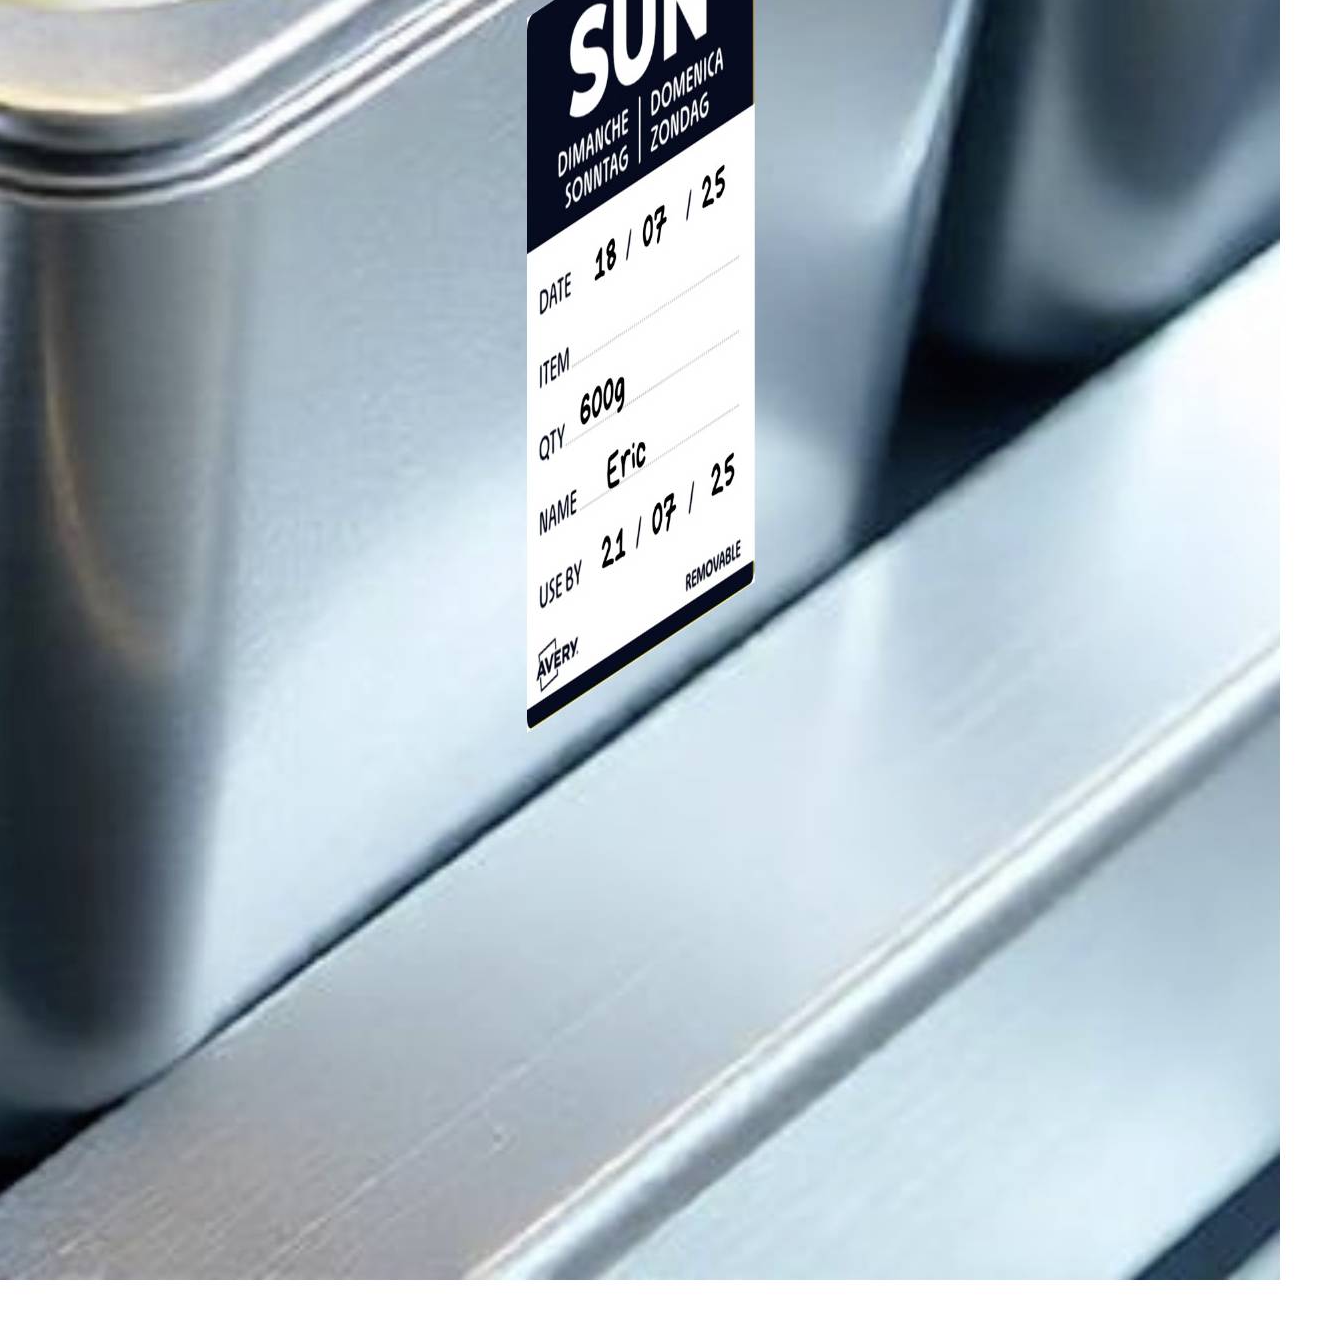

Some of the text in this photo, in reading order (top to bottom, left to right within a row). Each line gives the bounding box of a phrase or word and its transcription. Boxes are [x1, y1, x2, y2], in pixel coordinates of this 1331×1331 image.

[650, 47, 724, 117] DOMENICA
[558, 108, 629, 178] DIMANCHE
[650, 91, 710, 153] ZONDAG
[565, 144, 629, 209] SONNTAG
[594, 237, 617, 281] 18
[642, 204, 668, 248] 07
[701, 164, 726, 209] 25
[539, 272, 572, 315] DATE
[539, 347, 570, 389] ITEM
[579, 376, 625, 425] 600g
[539, 423, 566, 461] QTY
[606, 441, 646, 490] Eric
[539, 489, 577, 536] NAME
[601, 527, 626, 569] 21
[651, 492, 677, 536] 07
[710, 452, 735, 497] 25
[539, 559, 582, 609] USE BY
[685, 539, 741, 592] REMOVABLE
[536, 636, 579, 682] AVERY
